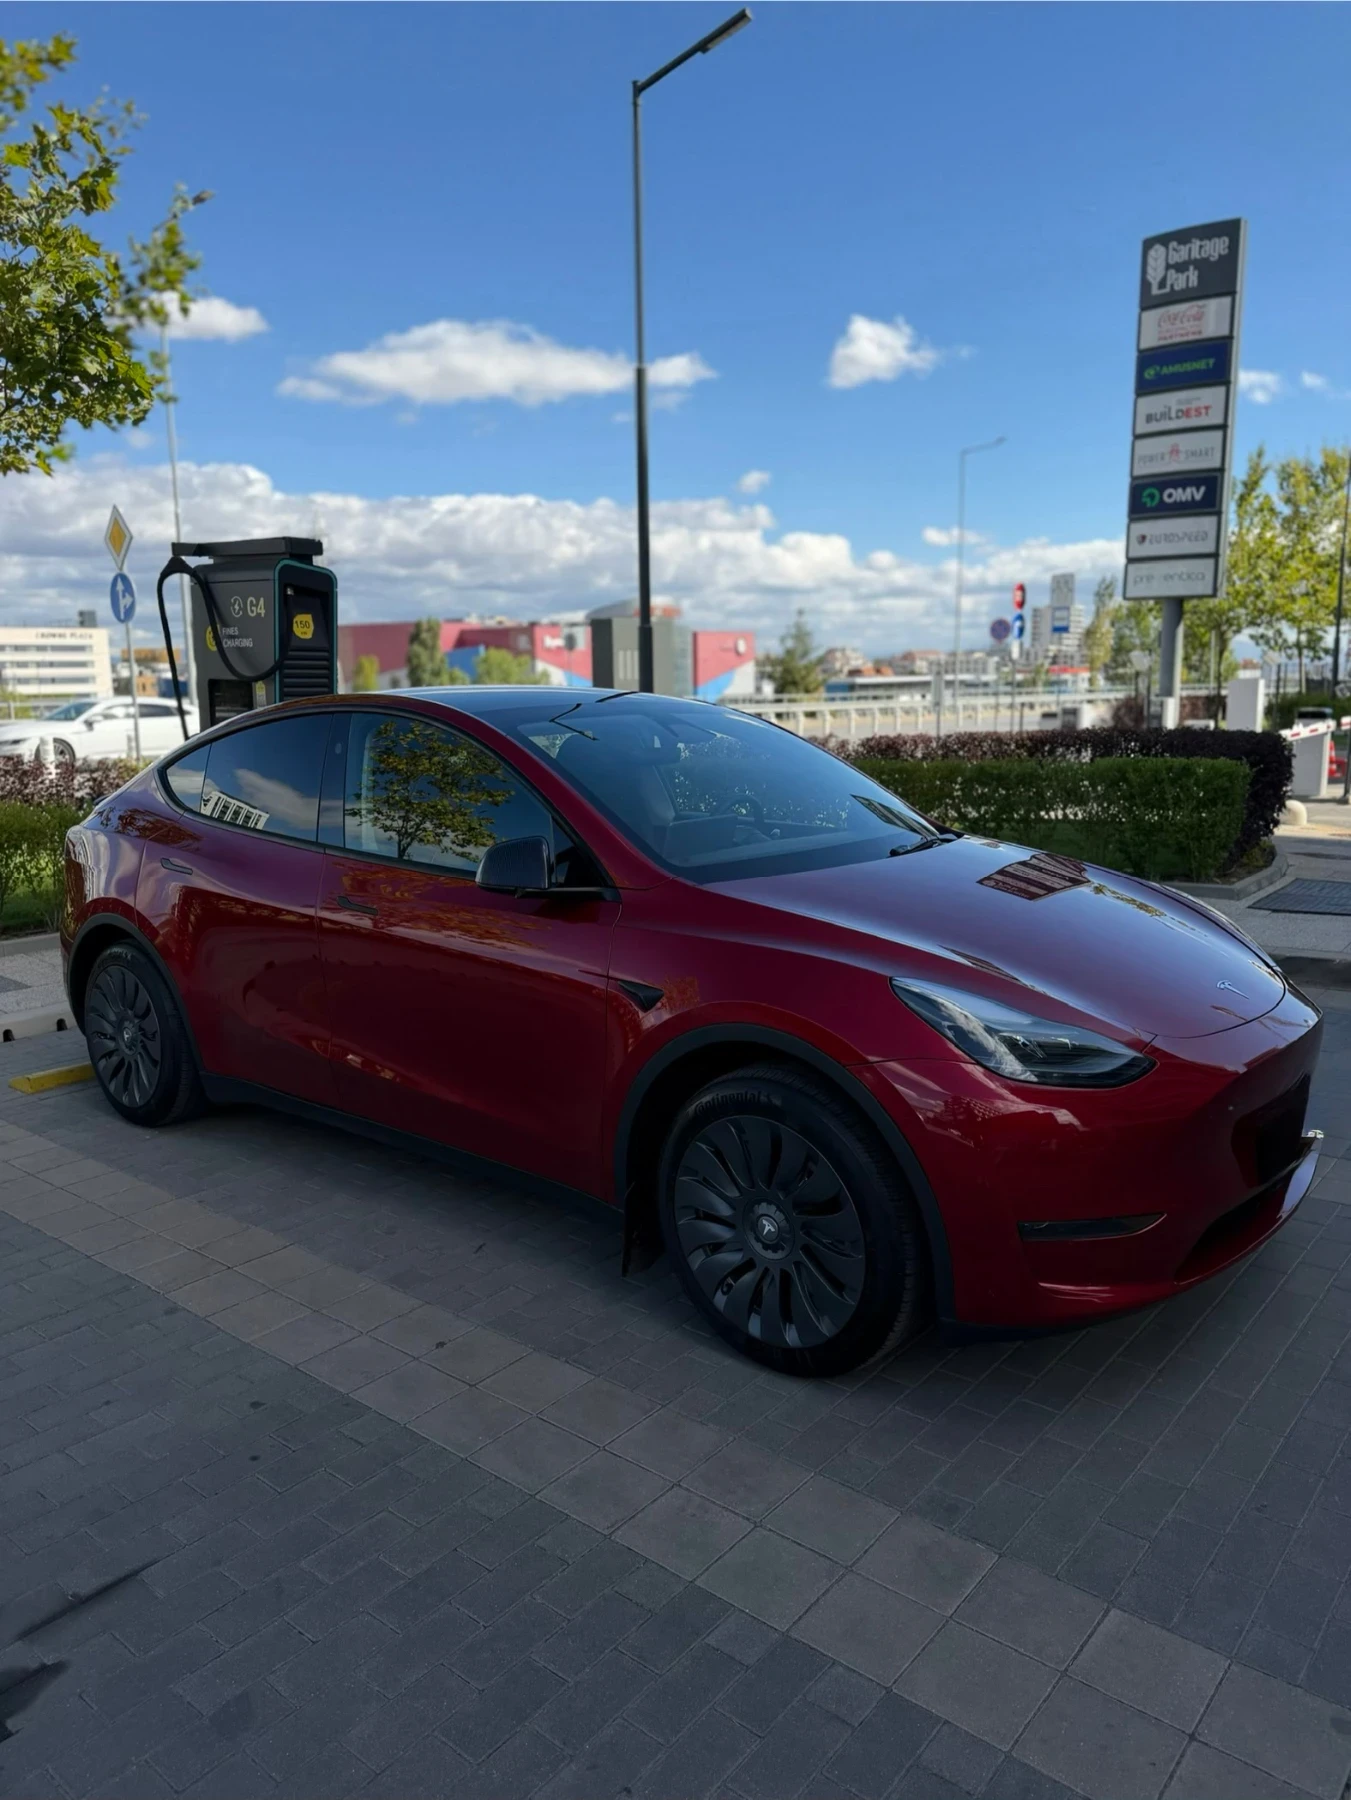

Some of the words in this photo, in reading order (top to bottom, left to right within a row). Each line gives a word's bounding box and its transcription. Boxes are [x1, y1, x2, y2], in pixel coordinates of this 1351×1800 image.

[1168, 236, 1229, 264] Garitage
[1165, 265, 1199, 292] Park
[1160, 358, 1215, 375] AMUSNET
[1185, 446, 1215, 459] SMART
[1162, 485, 1206, 503] OMV
[247, 596, 266, 618] G4
[295, 620, 311, 629] 150
[222, 638, 253, 648] CHARGING
